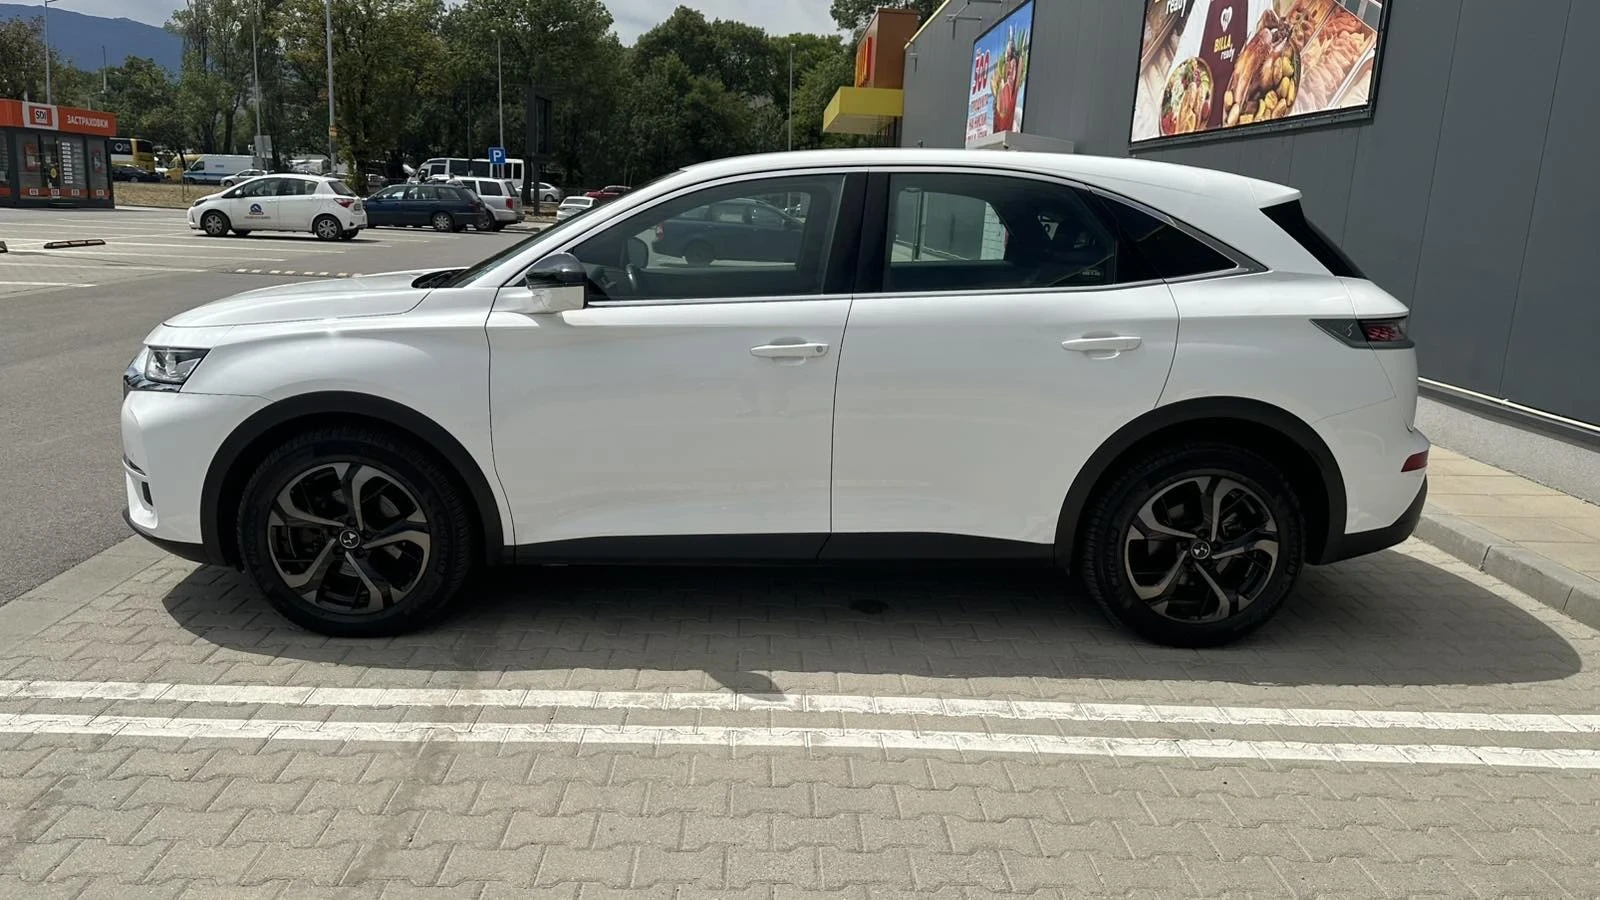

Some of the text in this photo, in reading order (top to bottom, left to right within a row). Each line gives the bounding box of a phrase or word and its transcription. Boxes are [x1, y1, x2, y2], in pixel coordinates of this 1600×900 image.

[1213, 34, 1231, 53] BILLA
[66, 114, 109, 129] ЗАСТРАХОВКИ
[493, 150, 502, 162] P
